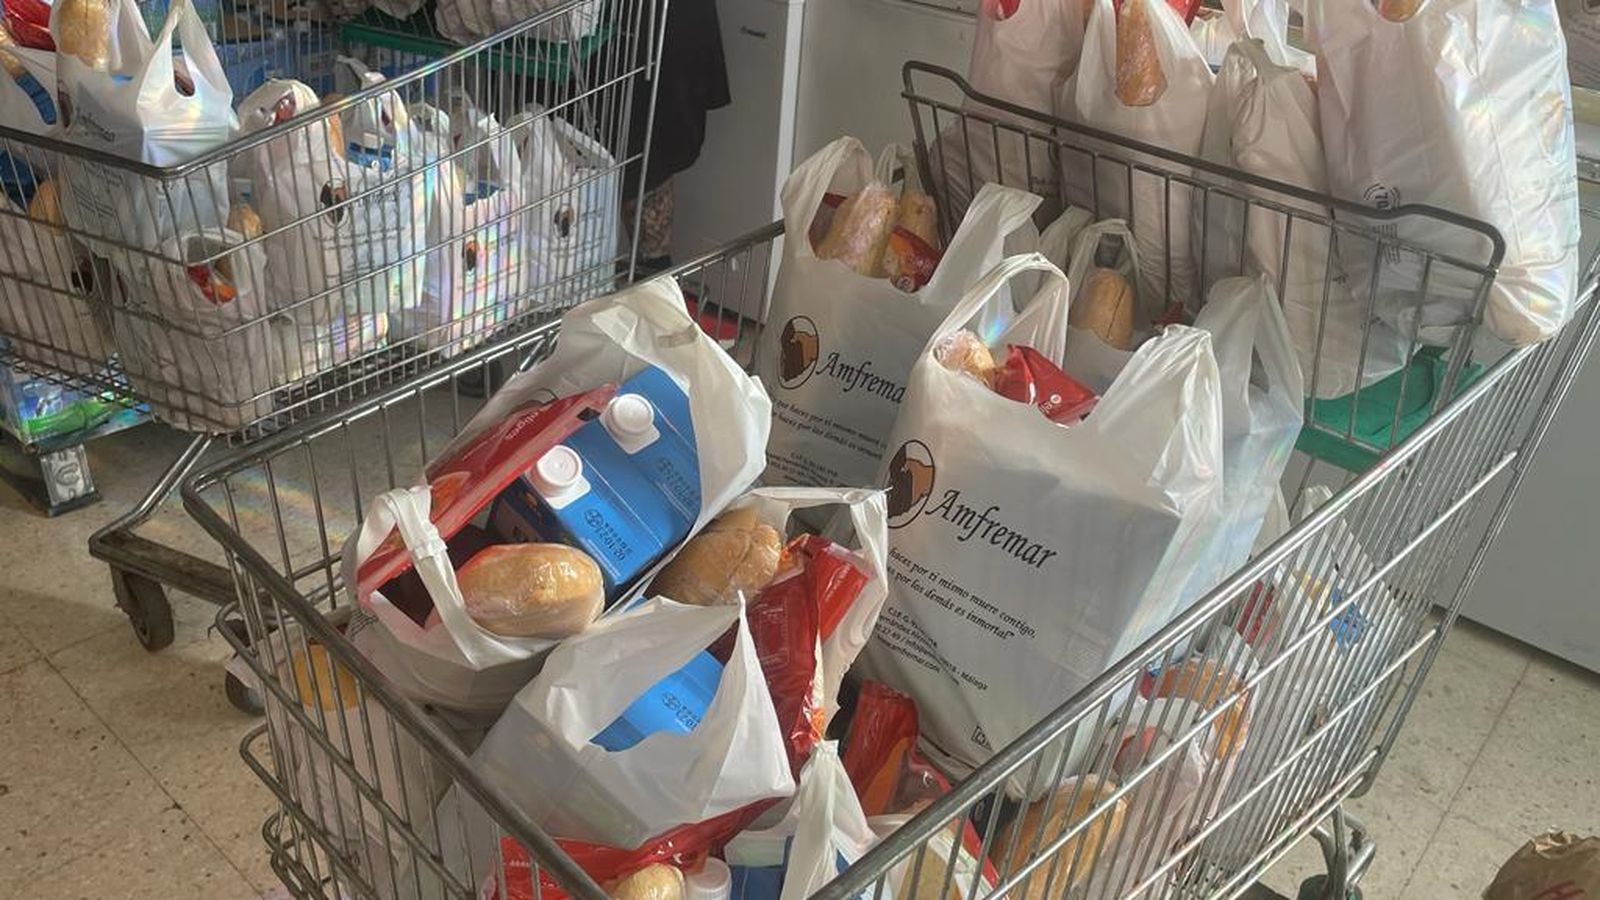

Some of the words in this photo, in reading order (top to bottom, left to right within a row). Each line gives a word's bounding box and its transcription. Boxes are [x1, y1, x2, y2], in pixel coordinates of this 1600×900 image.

[816, 352, 907, 404] Amfrema
[925, 489, 1057, 568] Amfremar
[909, 563, 929, 577] por
[938, 577, 970, 599] mismo
[970, 594, 999, 615] muere
